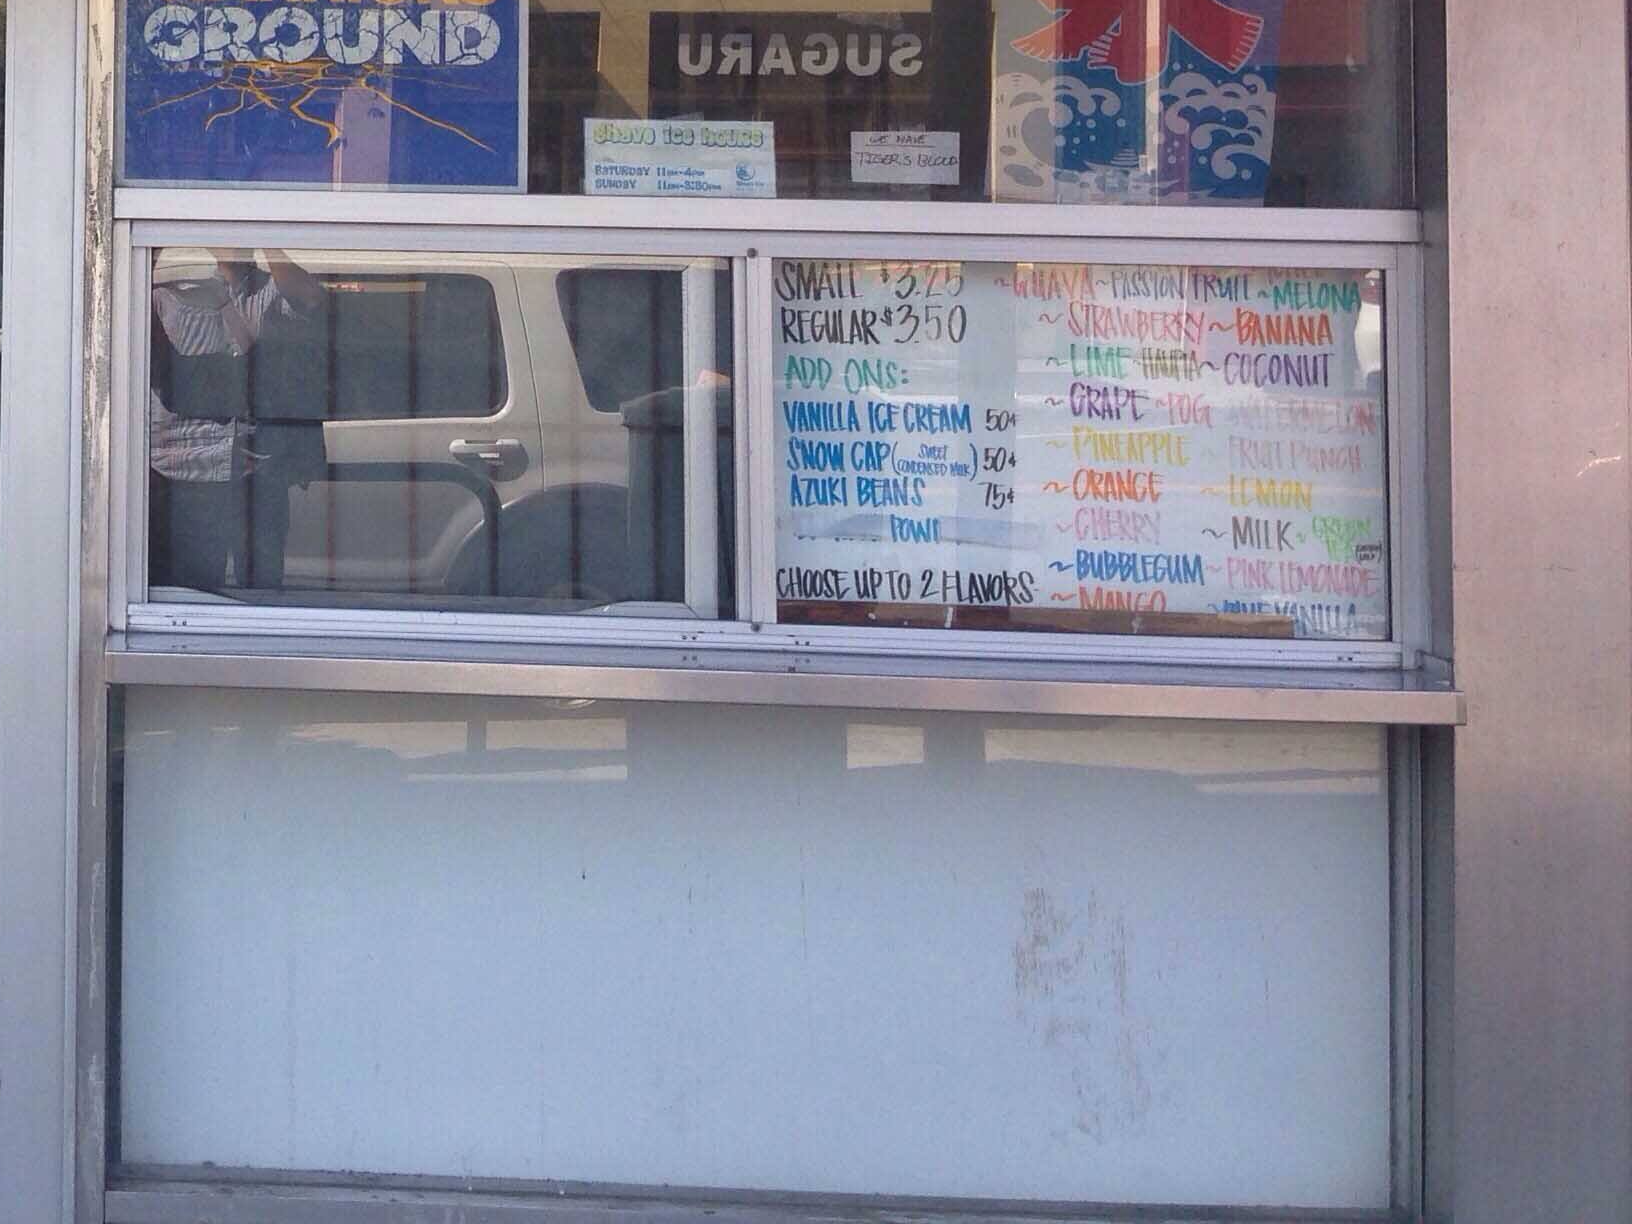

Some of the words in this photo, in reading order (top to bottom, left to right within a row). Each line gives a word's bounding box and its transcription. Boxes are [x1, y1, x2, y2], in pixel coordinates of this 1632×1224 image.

[144, 6, 502, 67] GROUND
[775, 261, 864, 301] SMALL
[1273, 280, 1362, 313] MELONA
[780, 306, 880, 345] REGULAR
[1069, 300, 1205, 344] STRAWBERRY
[1234, 308, 1334, 347] BANANA
[784, 354, 832, 391] ADD
[1070, 343, 1132, 378] LIME
[1223, 352, 1335, 388] COCONUT
[783, 400, 860, 434] VANILLA
[868, 401, 898, 434] ICE
[903, 401, 972, 434] CREAM
[1070, 382, 1150, 421] GRAPE
[787, 437, 844, 472] SNOW
[790, 474, 848, 507] AZUKI
[857, 475, 925, 507] BEANS
[1072, 469, 1163, 504] ORANGE
[1231, 515, 1295, 551] MILK
[776, 566, 850, 601] CHOOSE
[920, 570, 939, 598] 2
[1076, 549, 1206, 586] BUBBLEGUM
